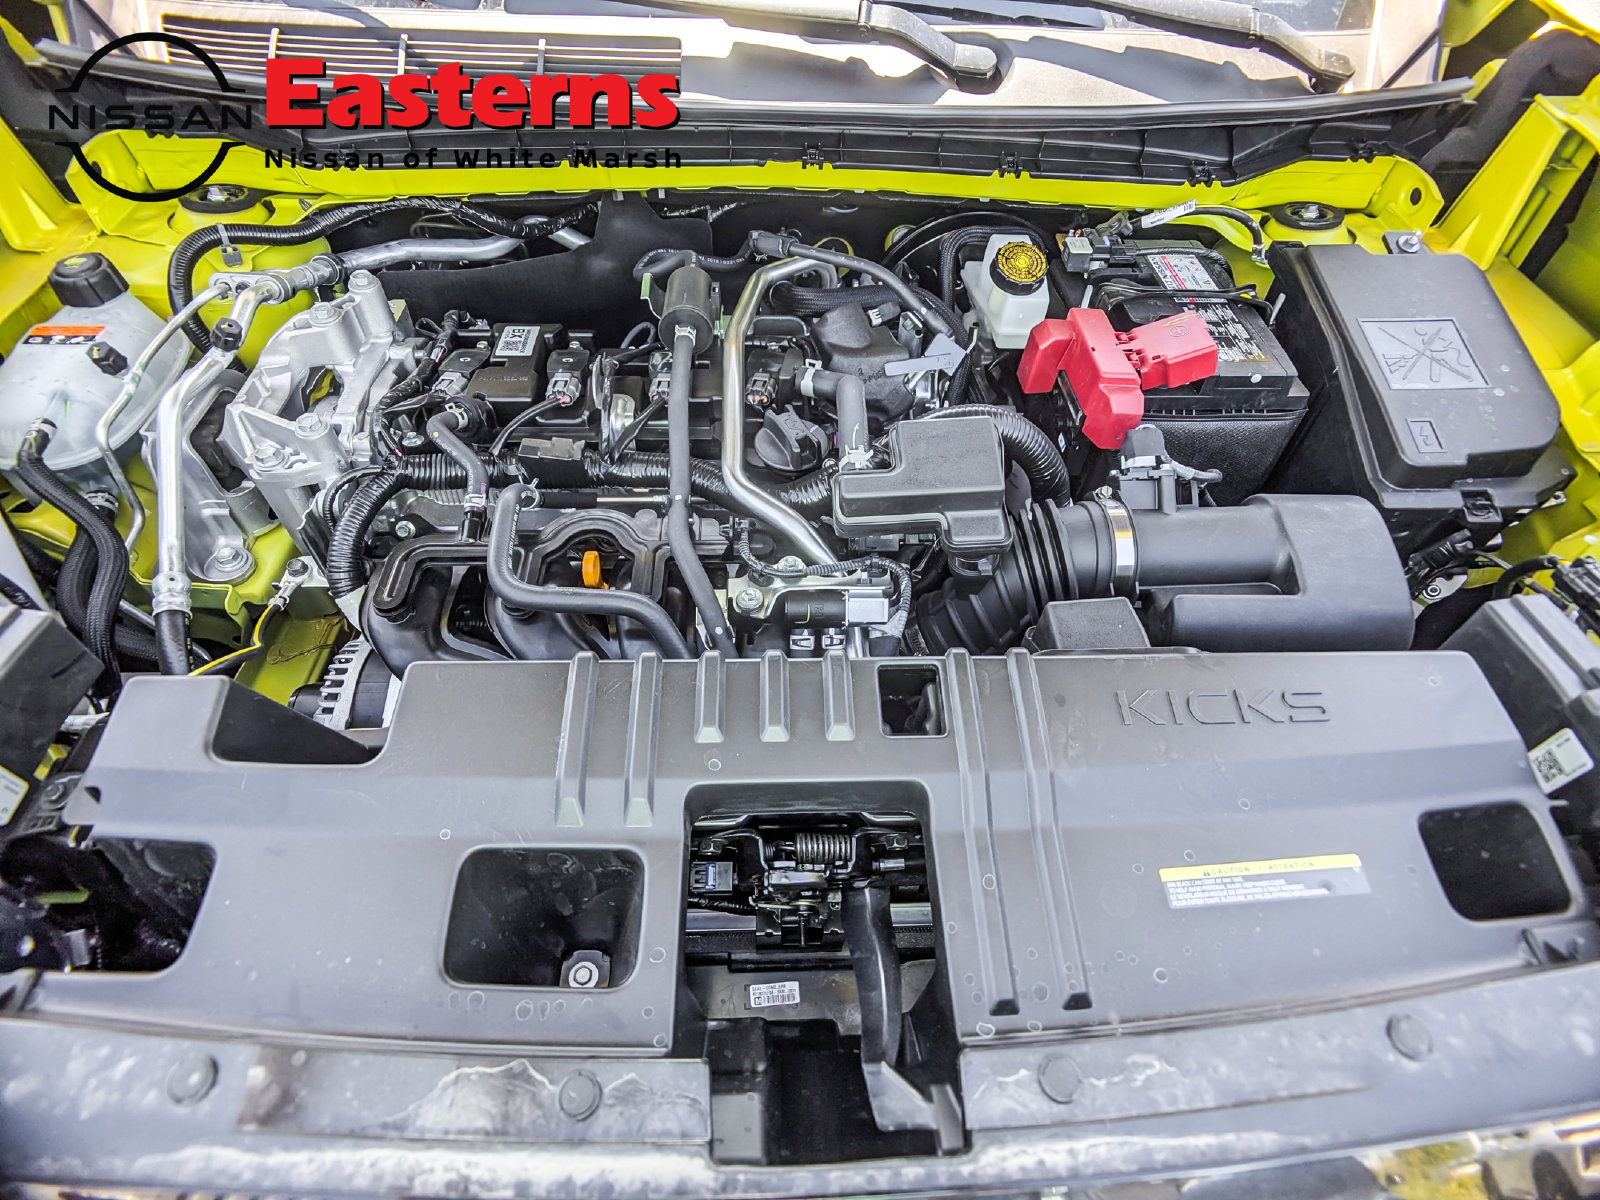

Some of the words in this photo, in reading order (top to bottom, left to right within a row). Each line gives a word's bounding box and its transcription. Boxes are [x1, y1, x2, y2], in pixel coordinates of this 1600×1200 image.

[511, 329, 526, 339] BX
[1115, 688, 1331, 726] KICKS
[1212, 866, 1250, 875] CAUTION
[1268, 862, 1315, 870] ATTENTION
